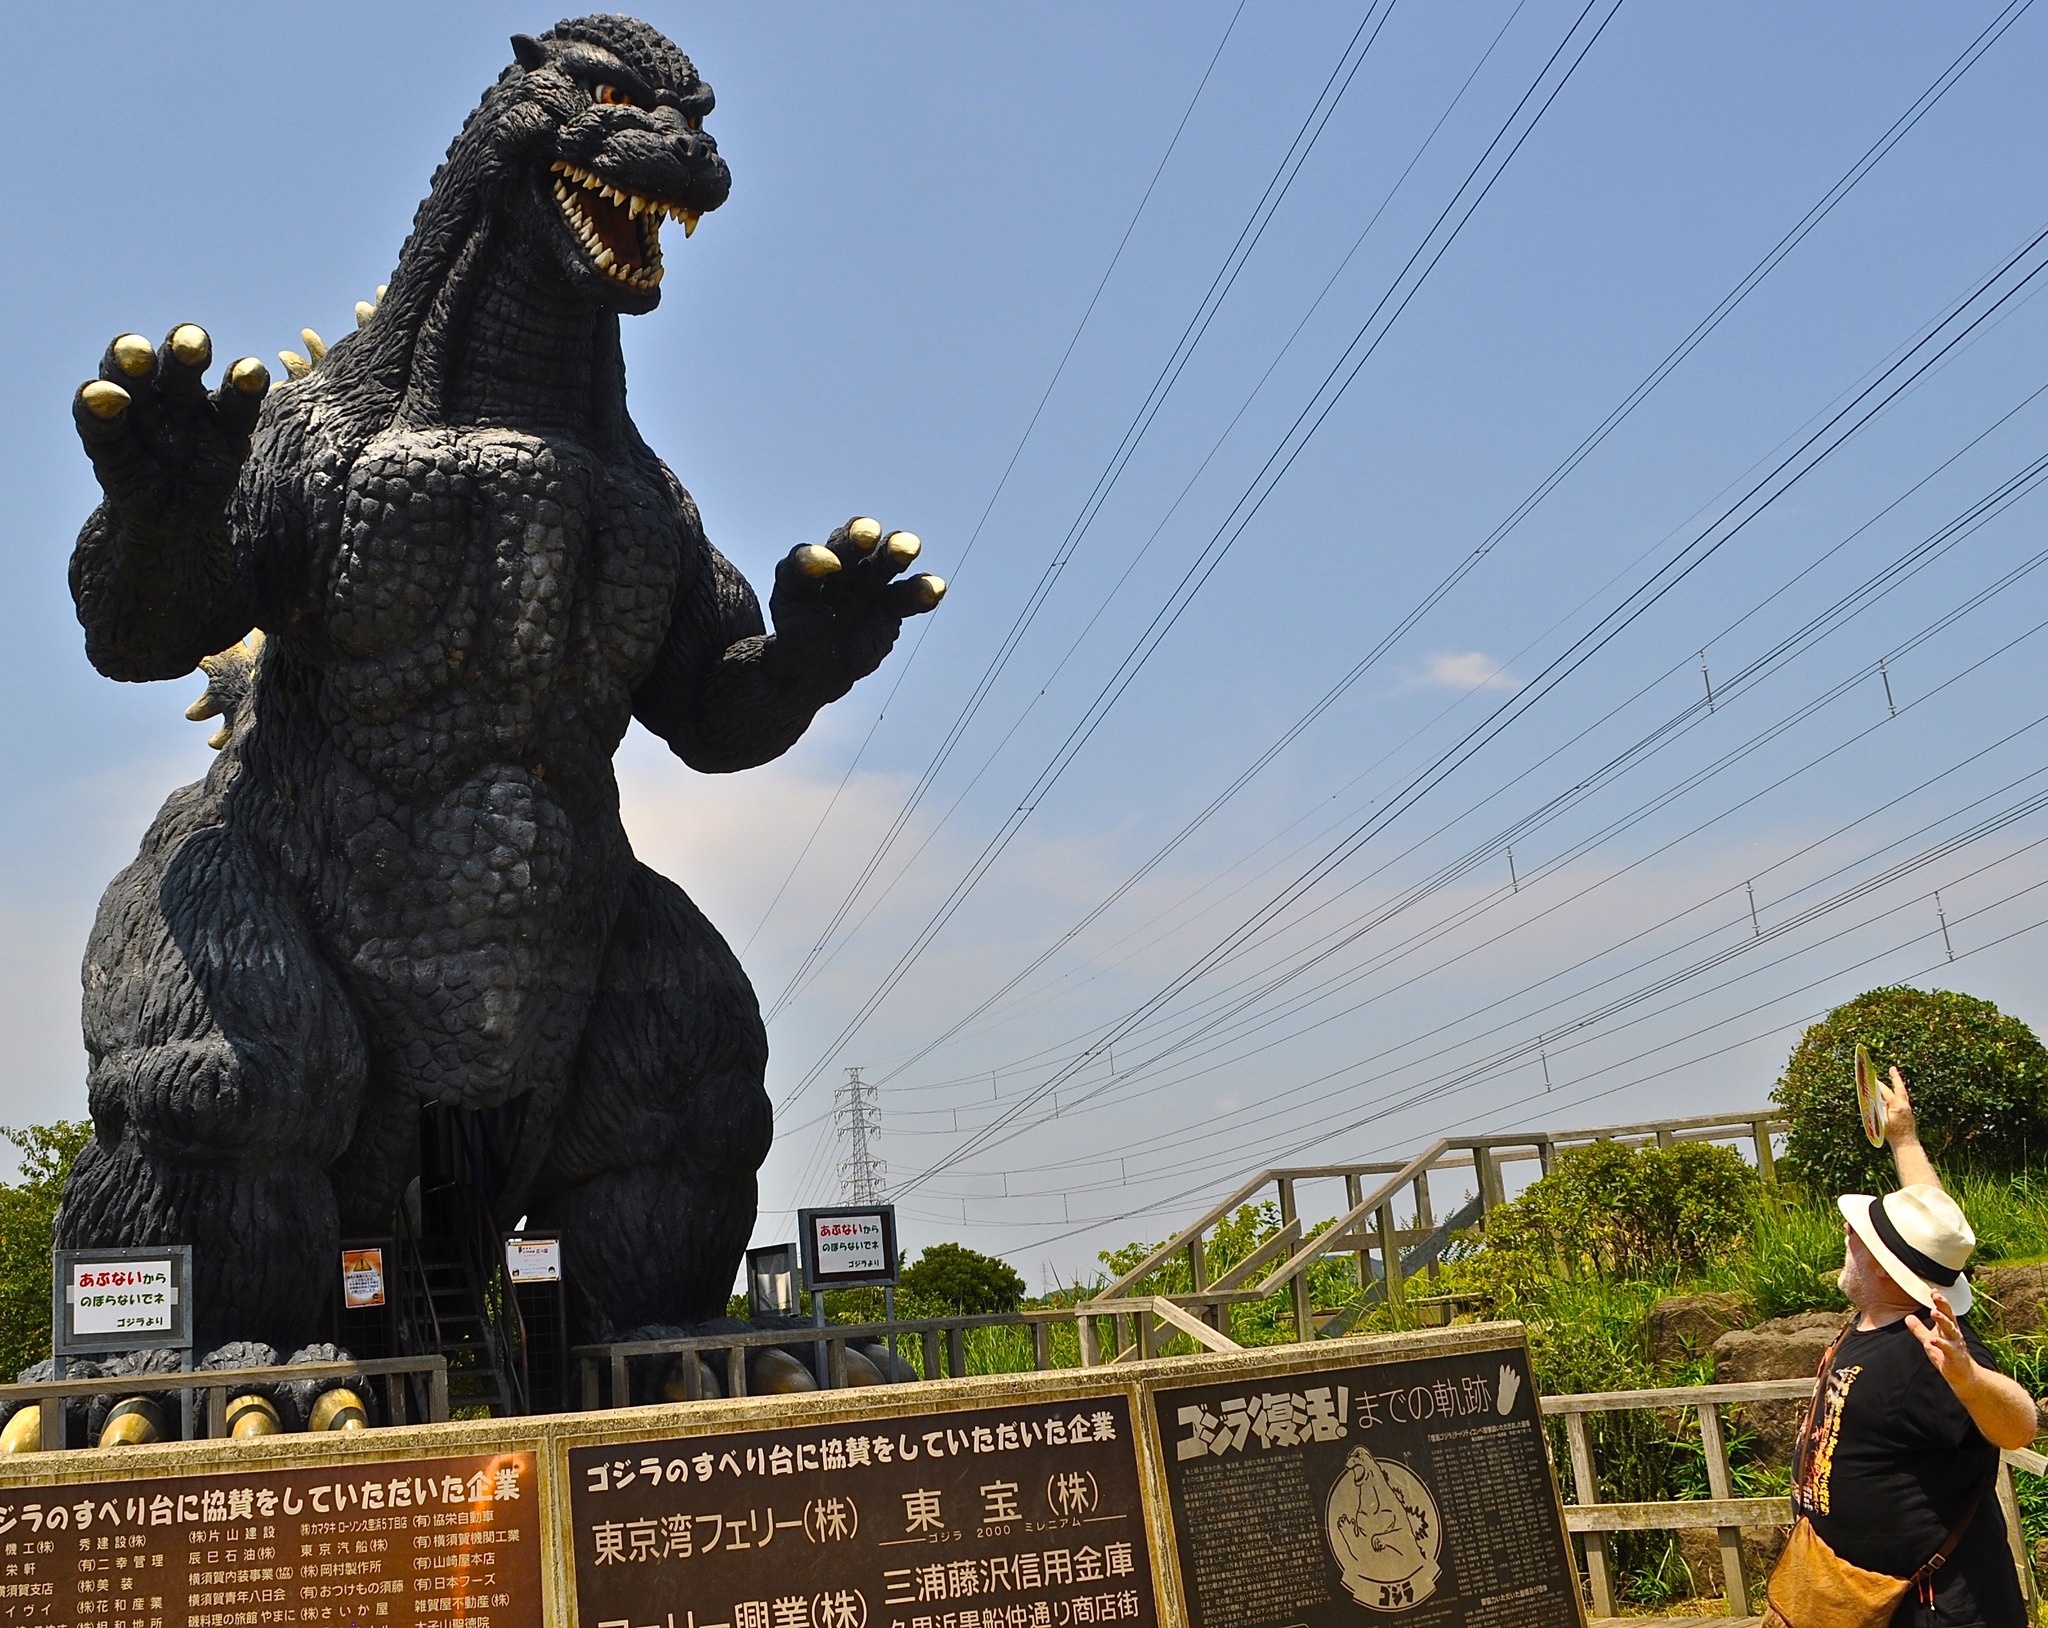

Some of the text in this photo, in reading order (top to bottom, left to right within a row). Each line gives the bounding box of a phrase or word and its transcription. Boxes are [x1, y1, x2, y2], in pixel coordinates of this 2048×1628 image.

[820, 1224, 879, 1237] あぶないから
[822, 1241, 879, 1252] のぼらないでネ
[849, 1259, 879, 1268] ゴジラより
[79, 1271, 167, 1287] あぶないから
[81, 1293, 165, 1307] のぼらないでネ
[117, 1317, 164, 1327] ゴジラより
[1355, 1374, 1490, 1429] までの軌跡
[587, 1411, 1117, 1492] ゴジラのすべり台に協賛をしていただいた企業
[592, 1496, 859, 1566] 東京湾フェリー(株)
[929, 1517, 1081, 1544] ゴジラ 2000 ミレニアム
[301, 1539, 388, 1557] 東京汽船(株)
[884, 1541, 1134, 1604] 三浦藤沢信用金庫
[300, 1602, 389, 1621] (株)さいか屋
